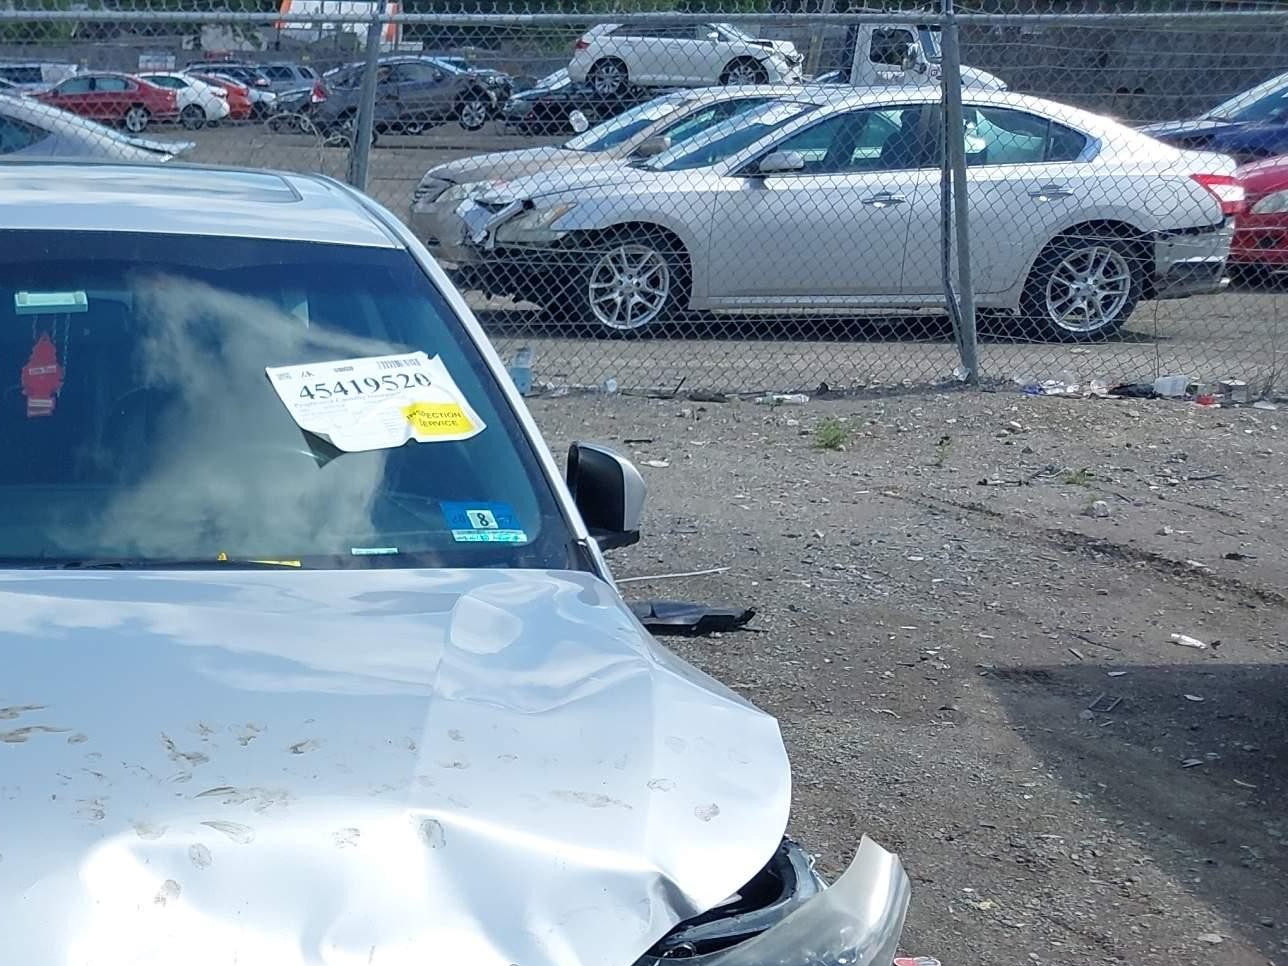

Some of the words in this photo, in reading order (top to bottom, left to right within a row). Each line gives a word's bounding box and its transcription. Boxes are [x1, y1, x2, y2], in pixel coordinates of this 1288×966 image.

[299, 372, 432, 400] 45419520
[406, 409, 462, 420] INSPECTION
[419, 417, 460, 427] SERVICE
[476, 512, 489, 526] 8
